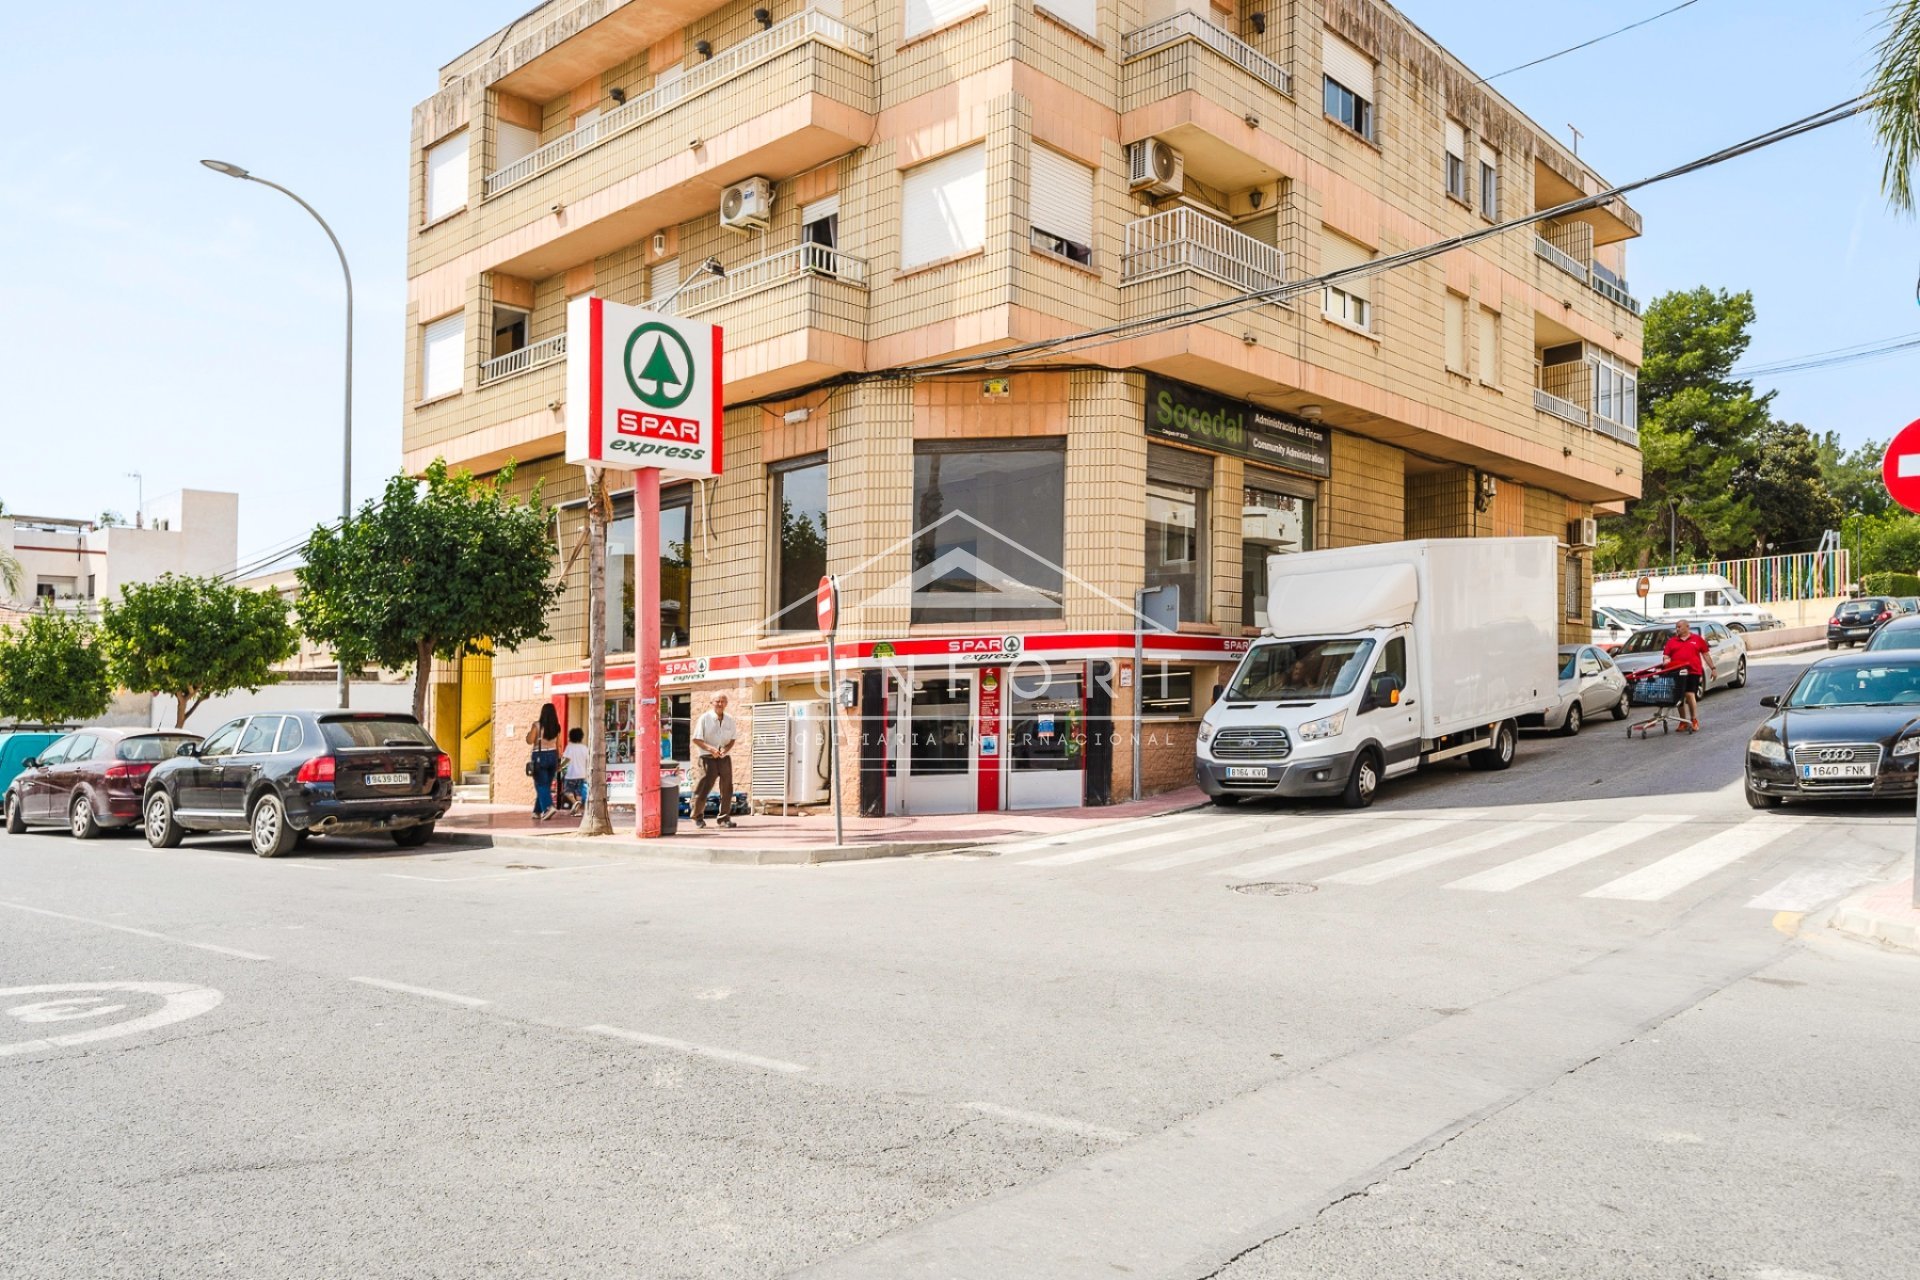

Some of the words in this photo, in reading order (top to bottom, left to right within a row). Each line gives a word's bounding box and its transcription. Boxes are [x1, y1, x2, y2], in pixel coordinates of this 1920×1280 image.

[1157, 390, 1243, 443] Socedal
[621, 413, 697, 440] SPAR
[1254, 413, 1297, 434] Administración
[1297, 425, 1305, 436] de
[1305, 427, 1323, 441] Fincas
[610, 439, 705, 460] express
[1253, 437, 1286, 457] Community
[1286, 446, 1325, 464] Administration
[948, 640, 1001, 652] SPAR
[1223, 640, 1249, 651] SPAR
[962, 652, 1021, 662] express
[665, 661, 697, 674] SPAR
[606, 772, 625, 781] PAR
[1813, 766, 1839, 776] 1640
[1845, 765, 1867, 776] FNK
[372, 775, 392, 783] 9439
